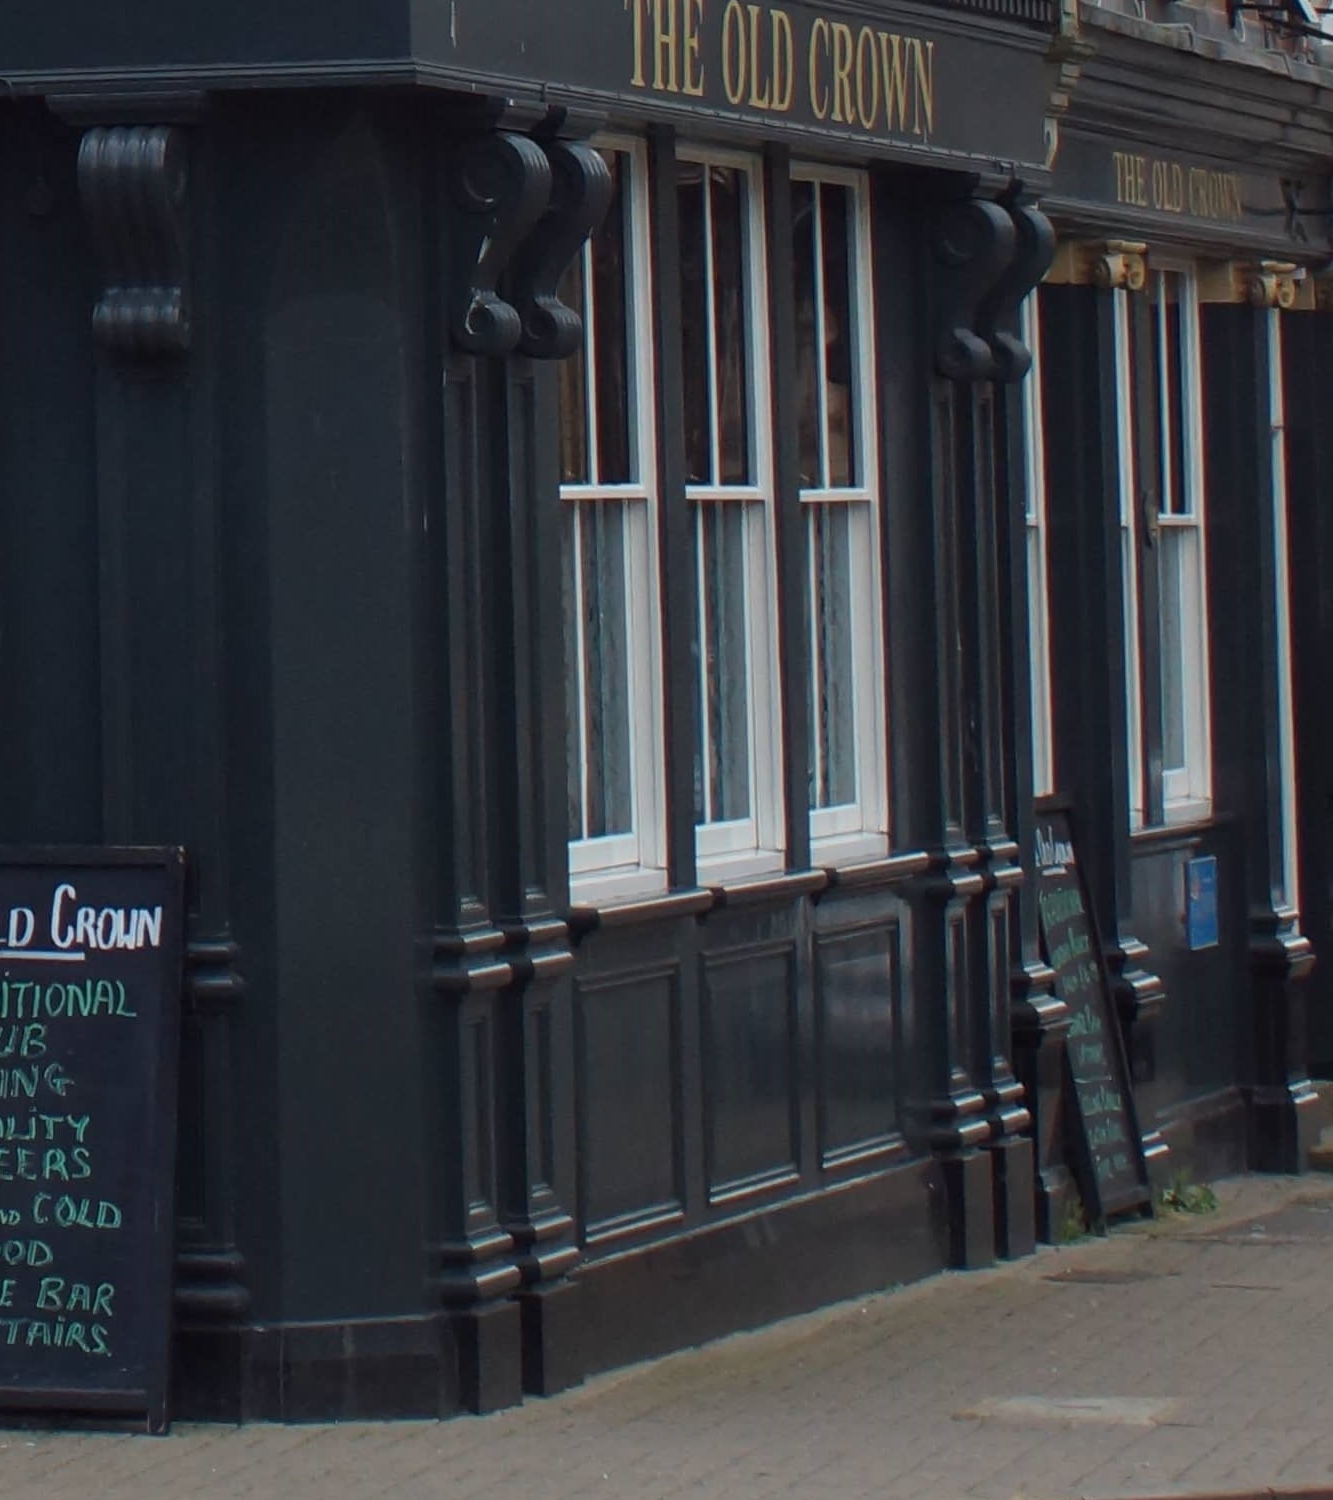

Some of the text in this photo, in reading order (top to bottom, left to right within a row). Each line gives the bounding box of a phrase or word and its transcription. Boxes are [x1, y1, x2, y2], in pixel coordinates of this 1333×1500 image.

[722, 0, 793, 112] OLD
[809, 17, 933, 137] CROWN
[1113, 152, 1148, 207] THE
[1152, 160, 1182, 213] OLD
[33, 1191, 123, 1229] COLD
[36, 1276, 115, 1317] BAR
